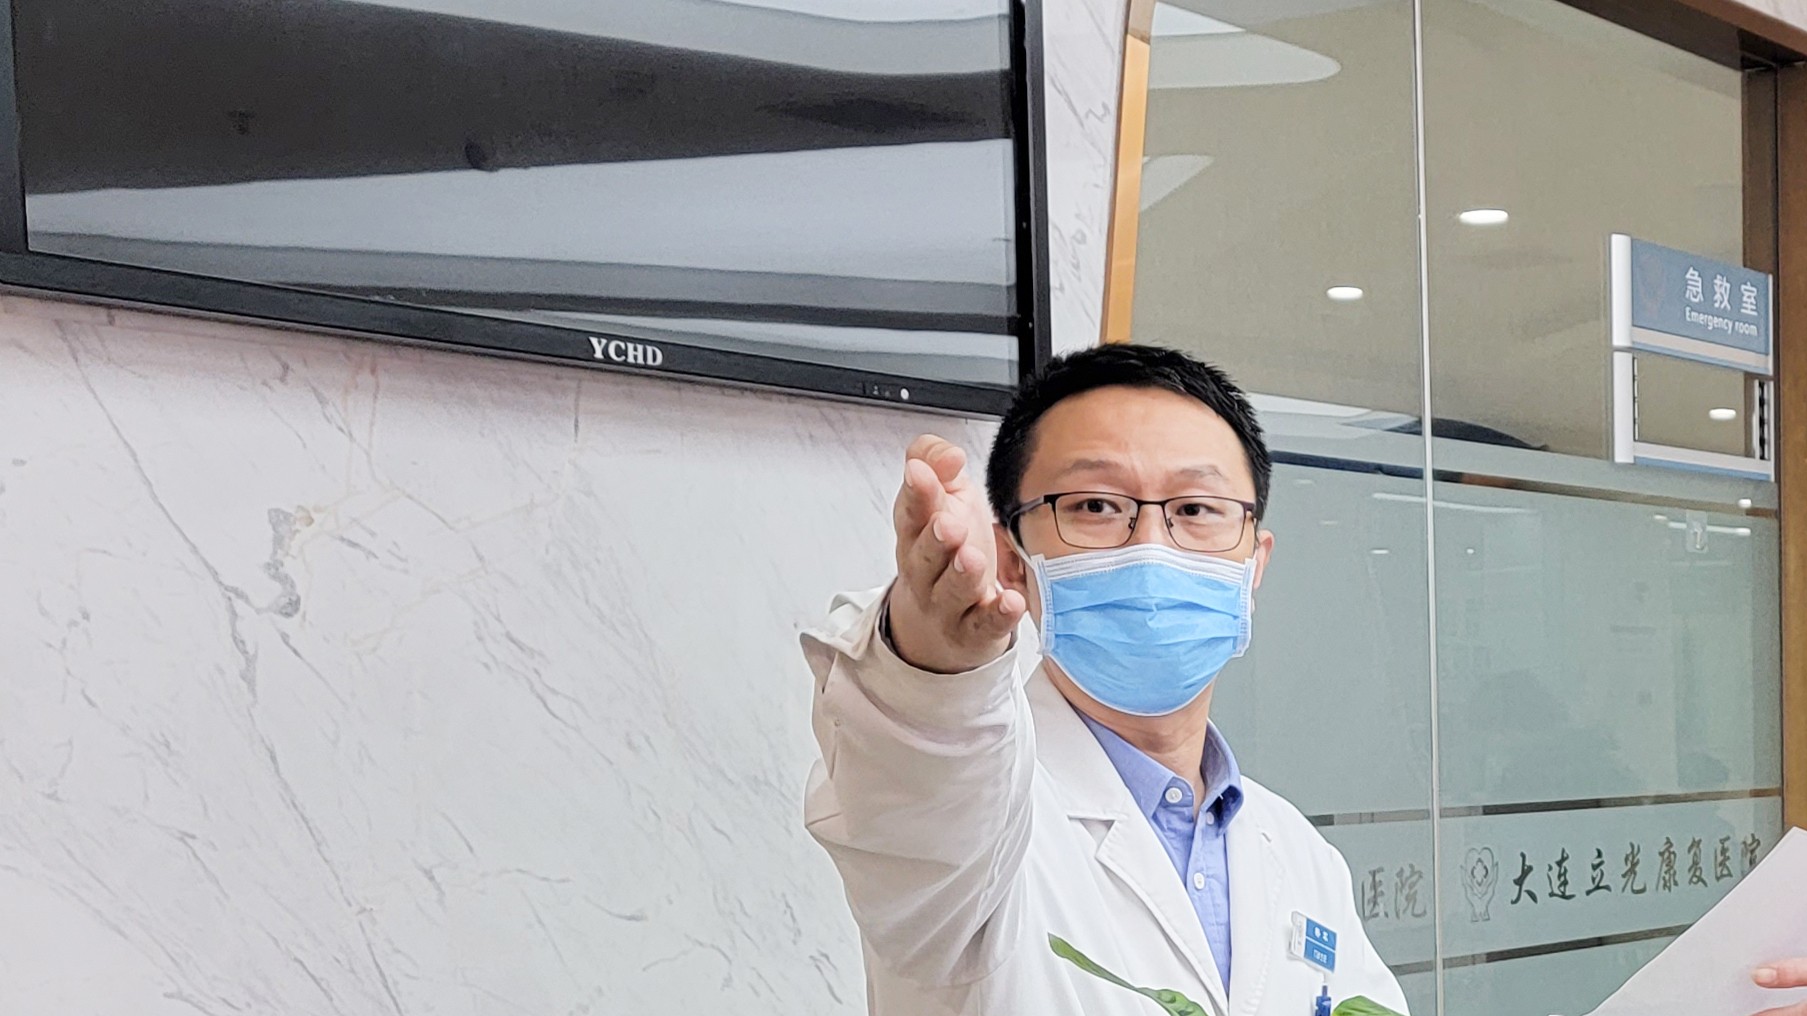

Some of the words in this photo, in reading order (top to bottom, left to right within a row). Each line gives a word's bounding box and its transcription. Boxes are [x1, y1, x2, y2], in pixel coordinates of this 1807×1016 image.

[1684, 266, 1759, 316] 急救室
[1685, 306, 1733, 335] Emergency
[1735, 320, 1758, 337] room
[588, 335, 663, 367] YCHD
[1361, 863, 1428, 920] 医院
[1510, 833, 1762, 906] 大连立光康复医院
